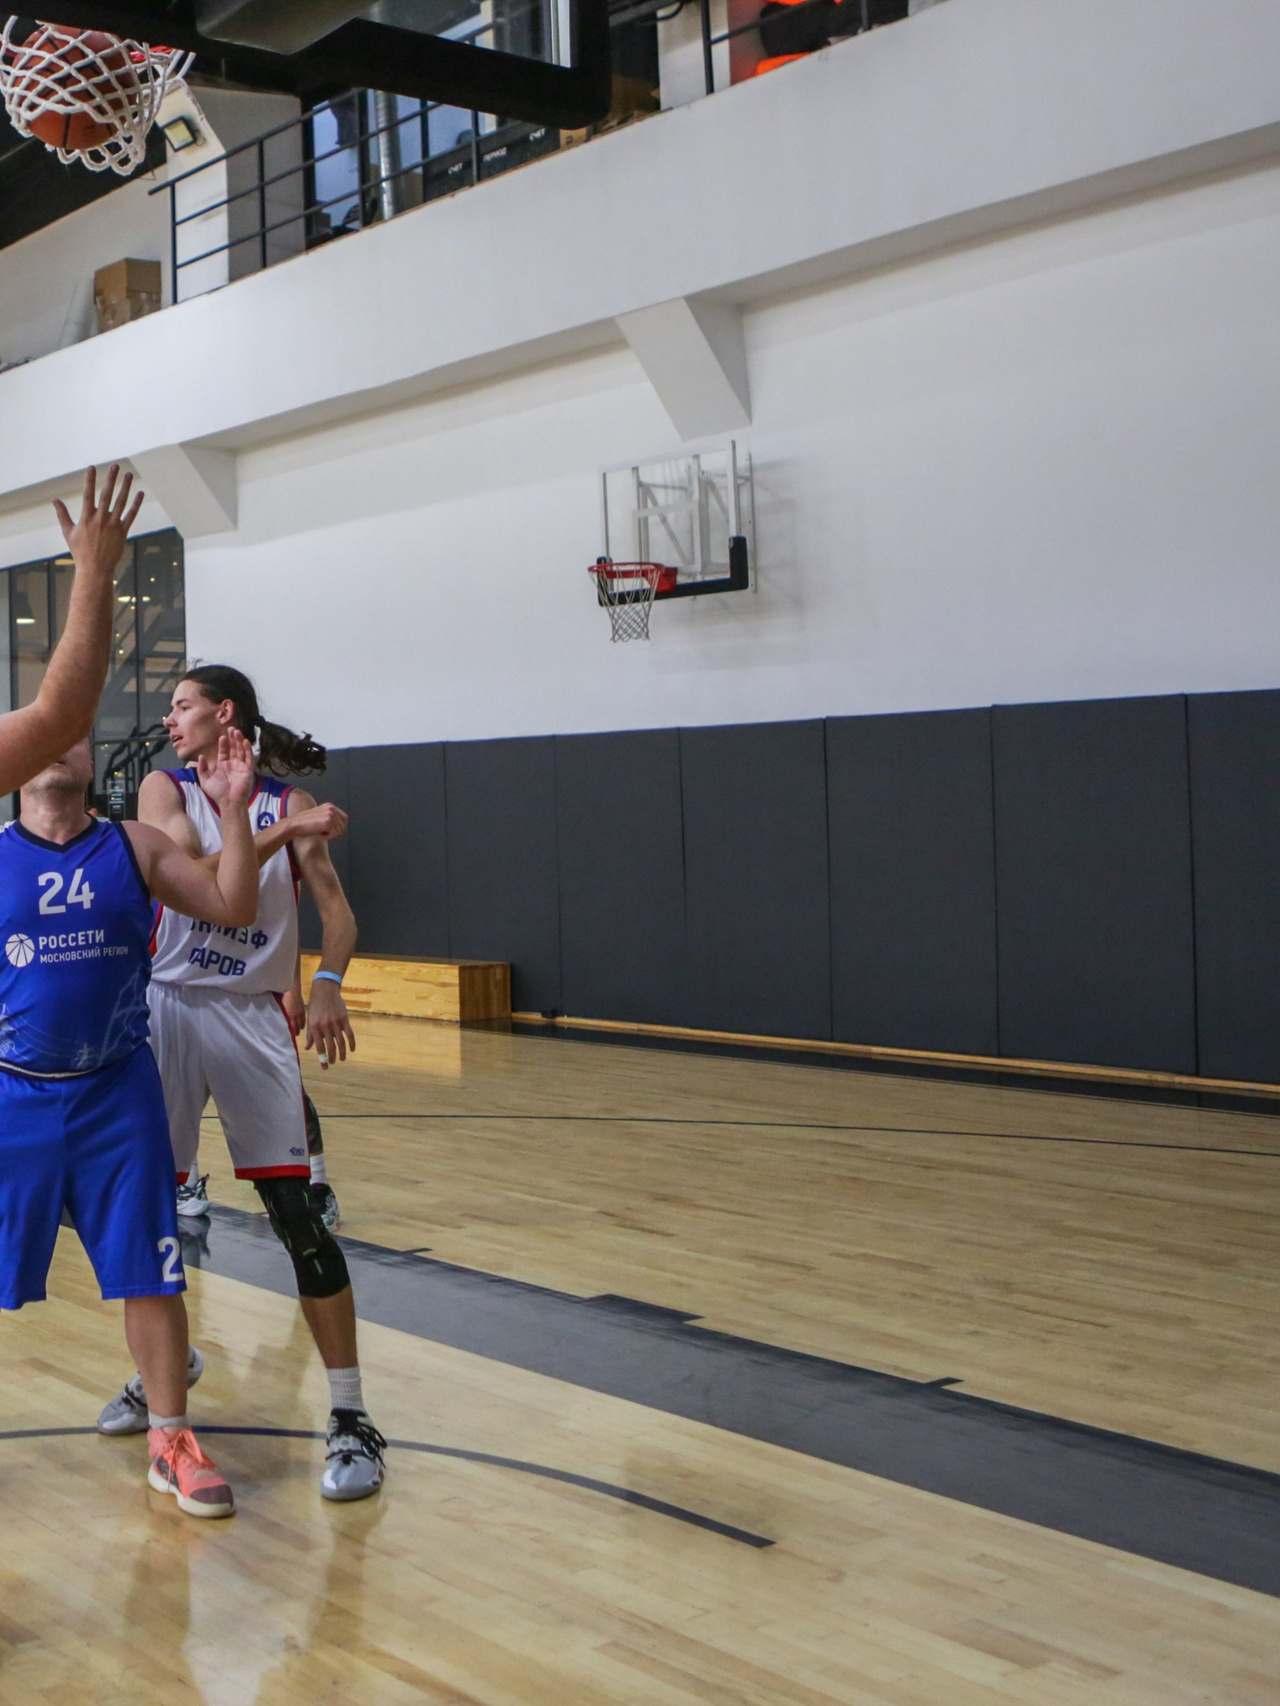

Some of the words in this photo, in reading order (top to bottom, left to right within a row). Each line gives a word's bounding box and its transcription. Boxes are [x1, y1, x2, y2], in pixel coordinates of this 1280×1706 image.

[37, 867, 95, 915] 24
[38, 929, 105, 950] РОССЕТИ
[40, 946, 101, 964] МОСКОВСКИЙ
[103, 945, 129, 957] РЕГИОН
